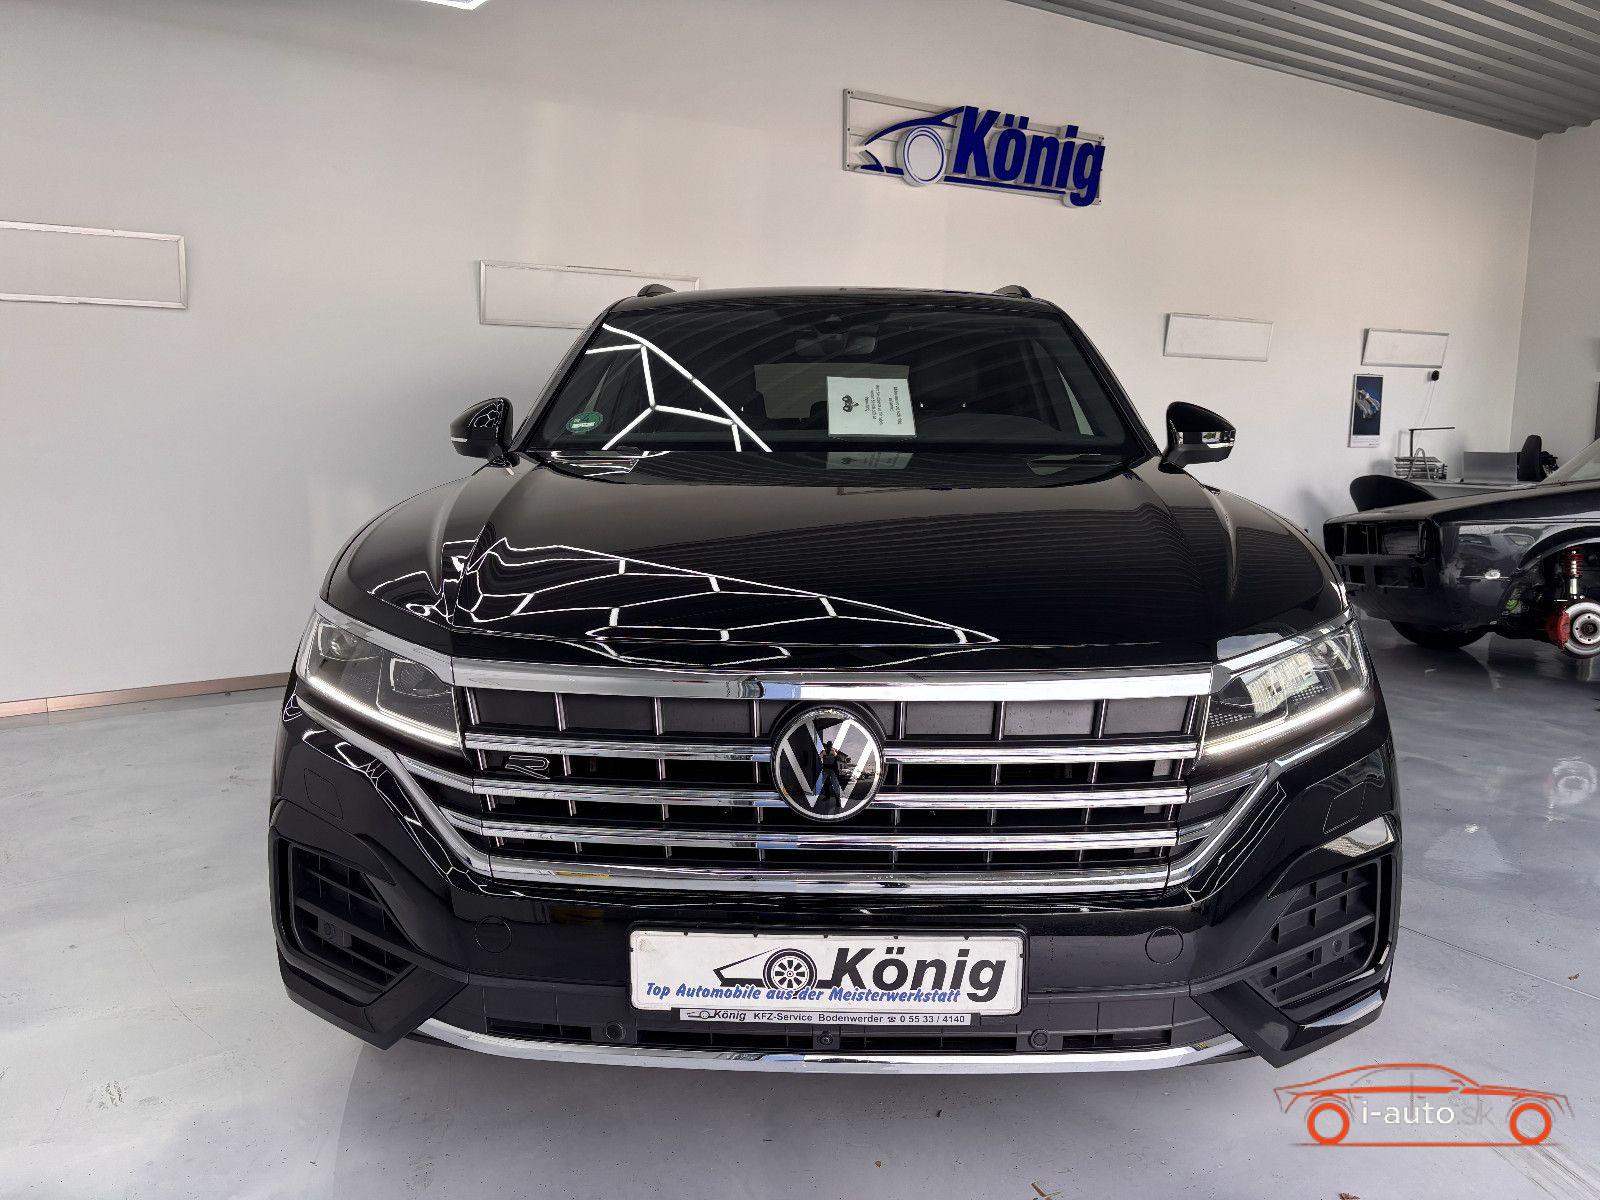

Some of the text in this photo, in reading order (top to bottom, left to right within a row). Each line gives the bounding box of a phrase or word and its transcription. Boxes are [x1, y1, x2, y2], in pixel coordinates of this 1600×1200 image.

[953, 105, 1106, 207] König
[646, 982, 962, 1003] Top Automobile aus der Meisterwerkstatt
[831, 946, 1007, 1003] König
[713, 1009, 747, 1022] König
[753, 1011, 813, 1022] KFZ-Service
[818, 1013, 884, 1024] Bodenwerder
[942, 1015, 965, 1023] 4140
